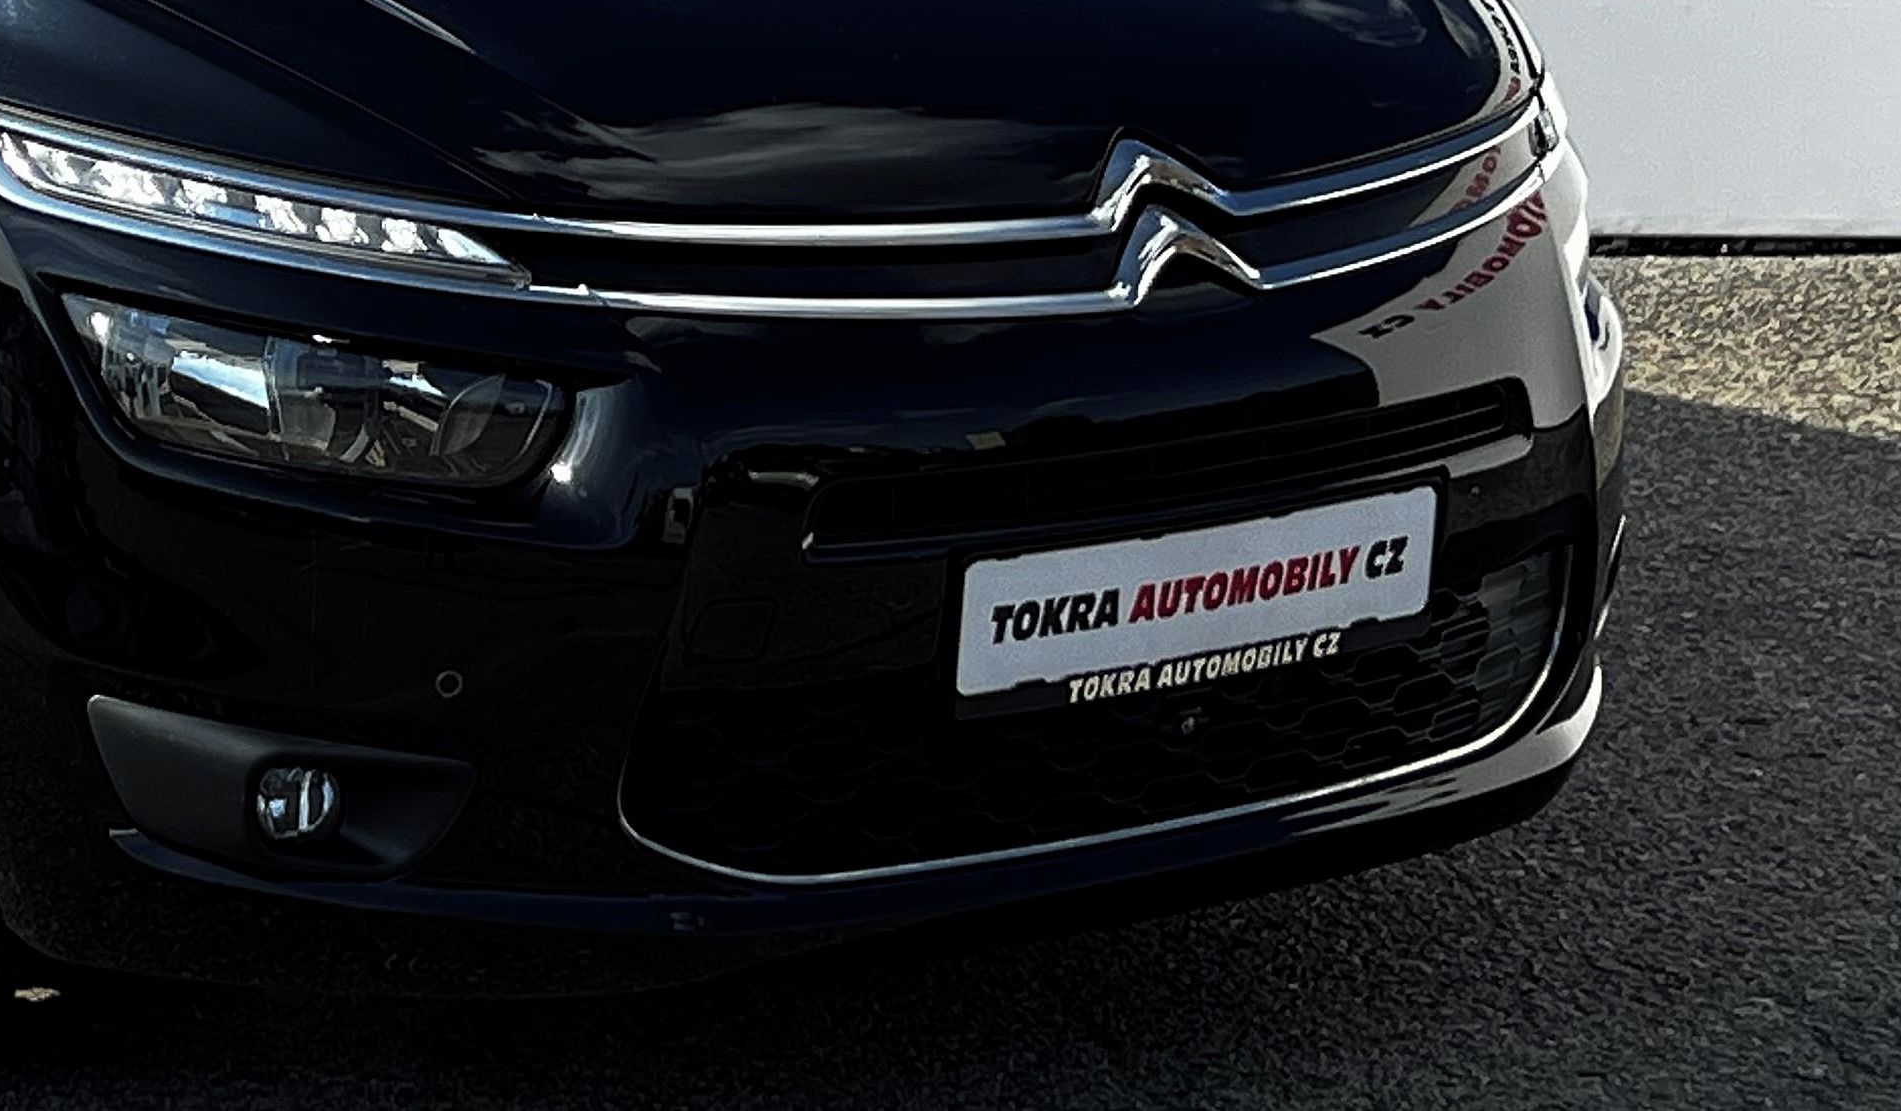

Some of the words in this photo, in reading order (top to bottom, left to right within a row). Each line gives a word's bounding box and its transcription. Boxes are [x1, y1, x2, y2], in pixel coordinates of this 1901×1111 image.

[991, 589, 1119, 645] TOKRA
[1129, 545, 1362, 623] AUTOMOBILY
[1364, 536, 1409, 579] CZ
[1068, 667, 1152, 704] TOKRA
[1157, 637, 1306, 688] AUTOMOBILY
[1312, 632, 1341, 657] CZ
